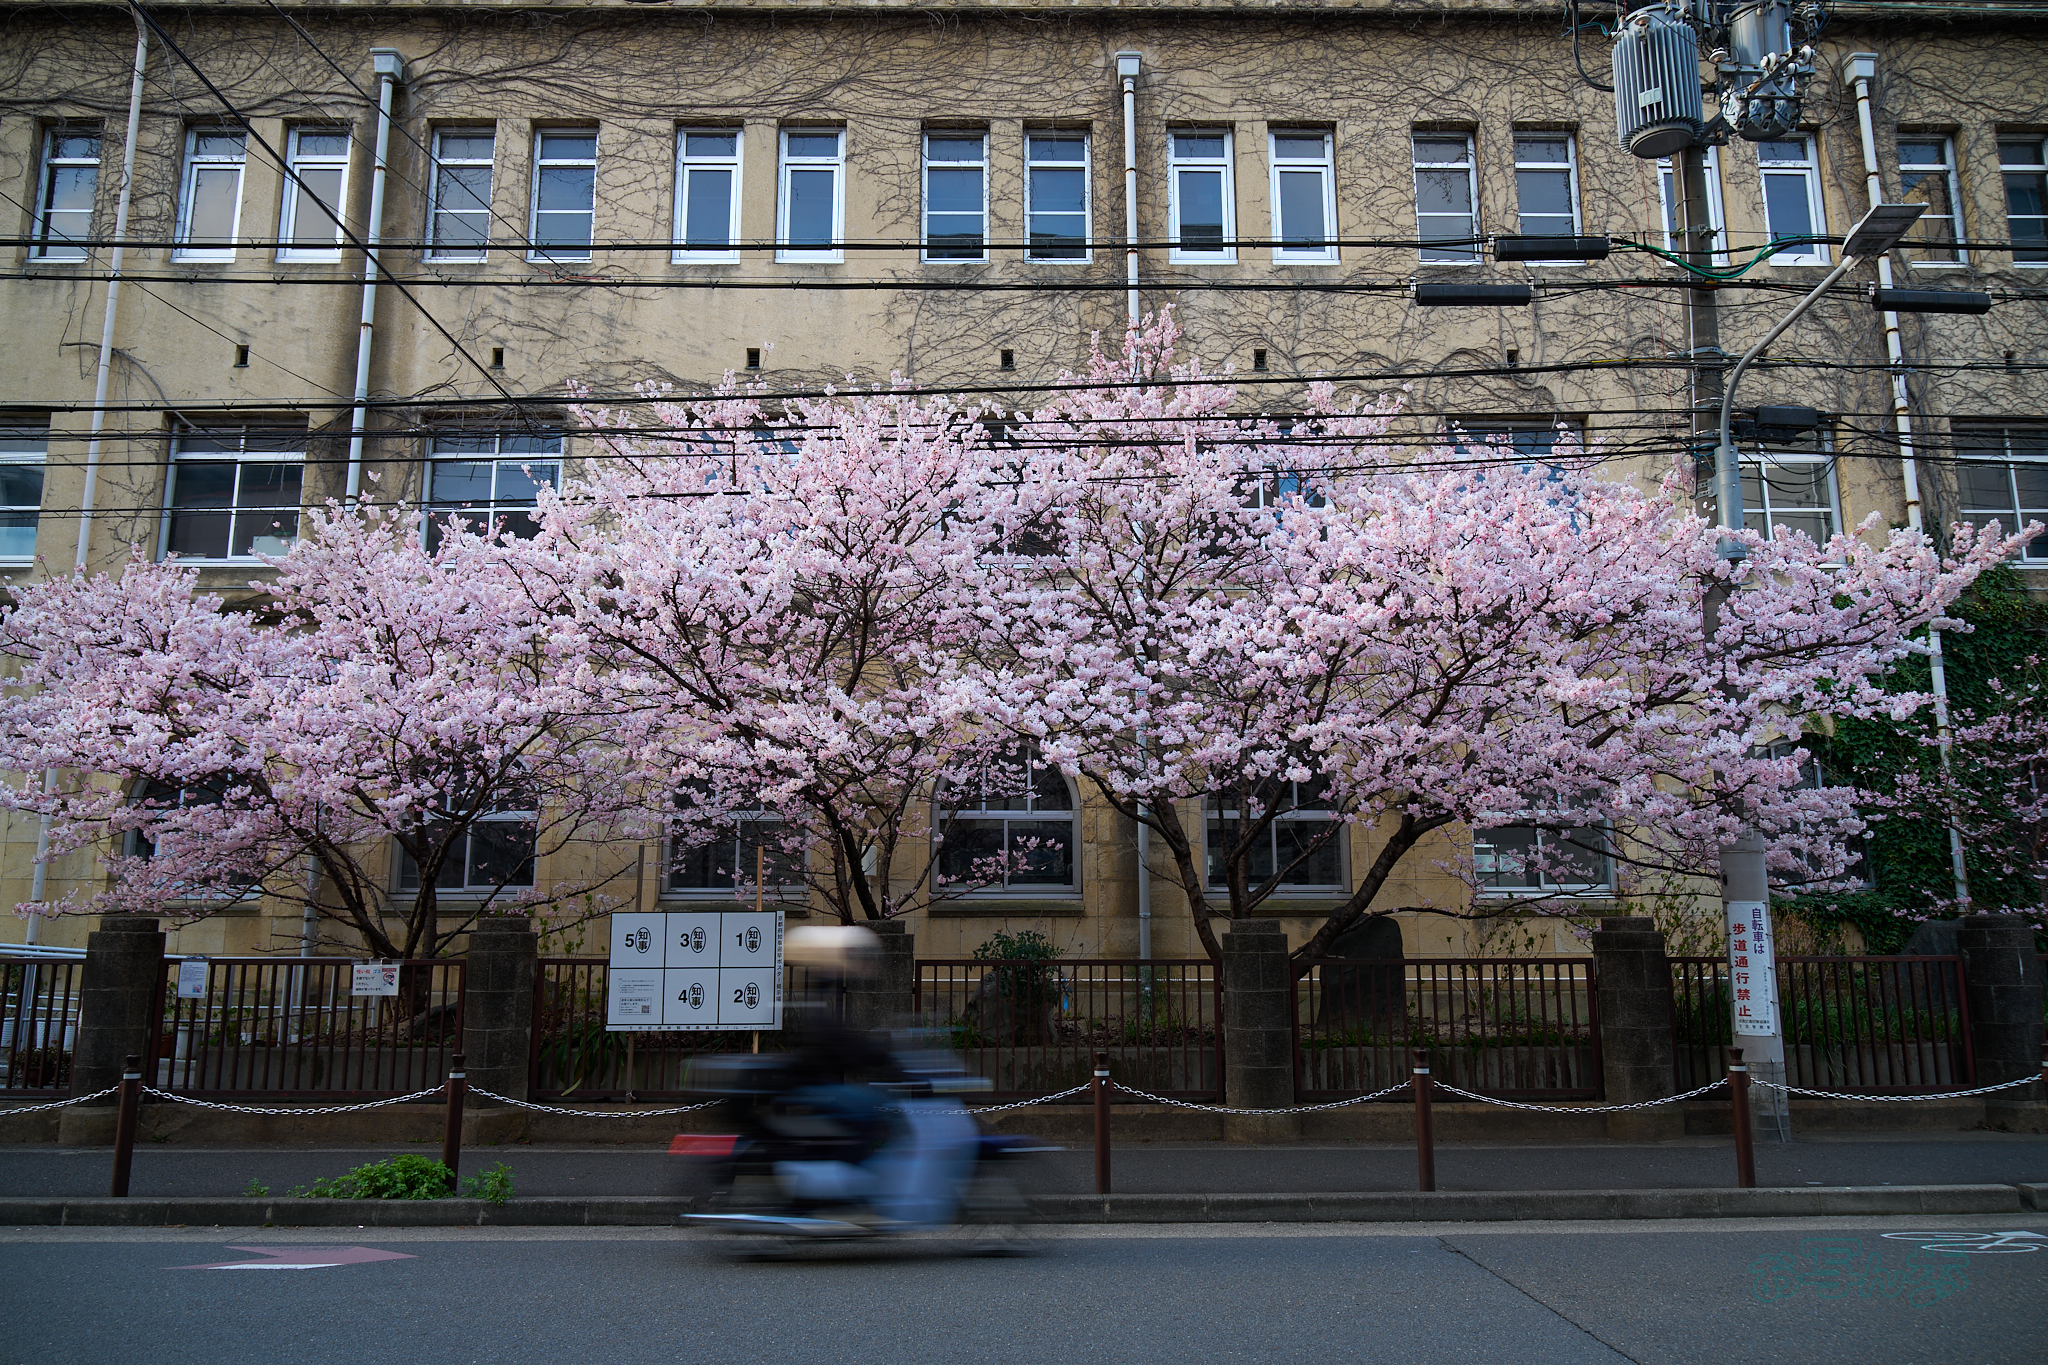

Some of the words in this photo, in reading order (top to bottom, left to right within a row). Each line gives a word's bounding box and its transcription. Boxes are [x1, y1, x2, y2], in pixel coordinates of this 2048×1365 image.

[624, 933, 635, 948] 5
[637, 930, 649, 951] 知事
[680, 933, 690, 948] 3
[692, 930, 704, 951] 知事
[735, 932, 743, 947] 1
[747, 930, 759, 950] 知事
[1751, 907, 1765, 955] 自転車は
[1732, 922, 1752, 1018] 歩道通行禁止
[678, 989, 688, 1004] 4
[691, 986, 702, 1007] 知事
[733, 988, 743, 1003] 2
[746, 986, 757, 1006] 知事
